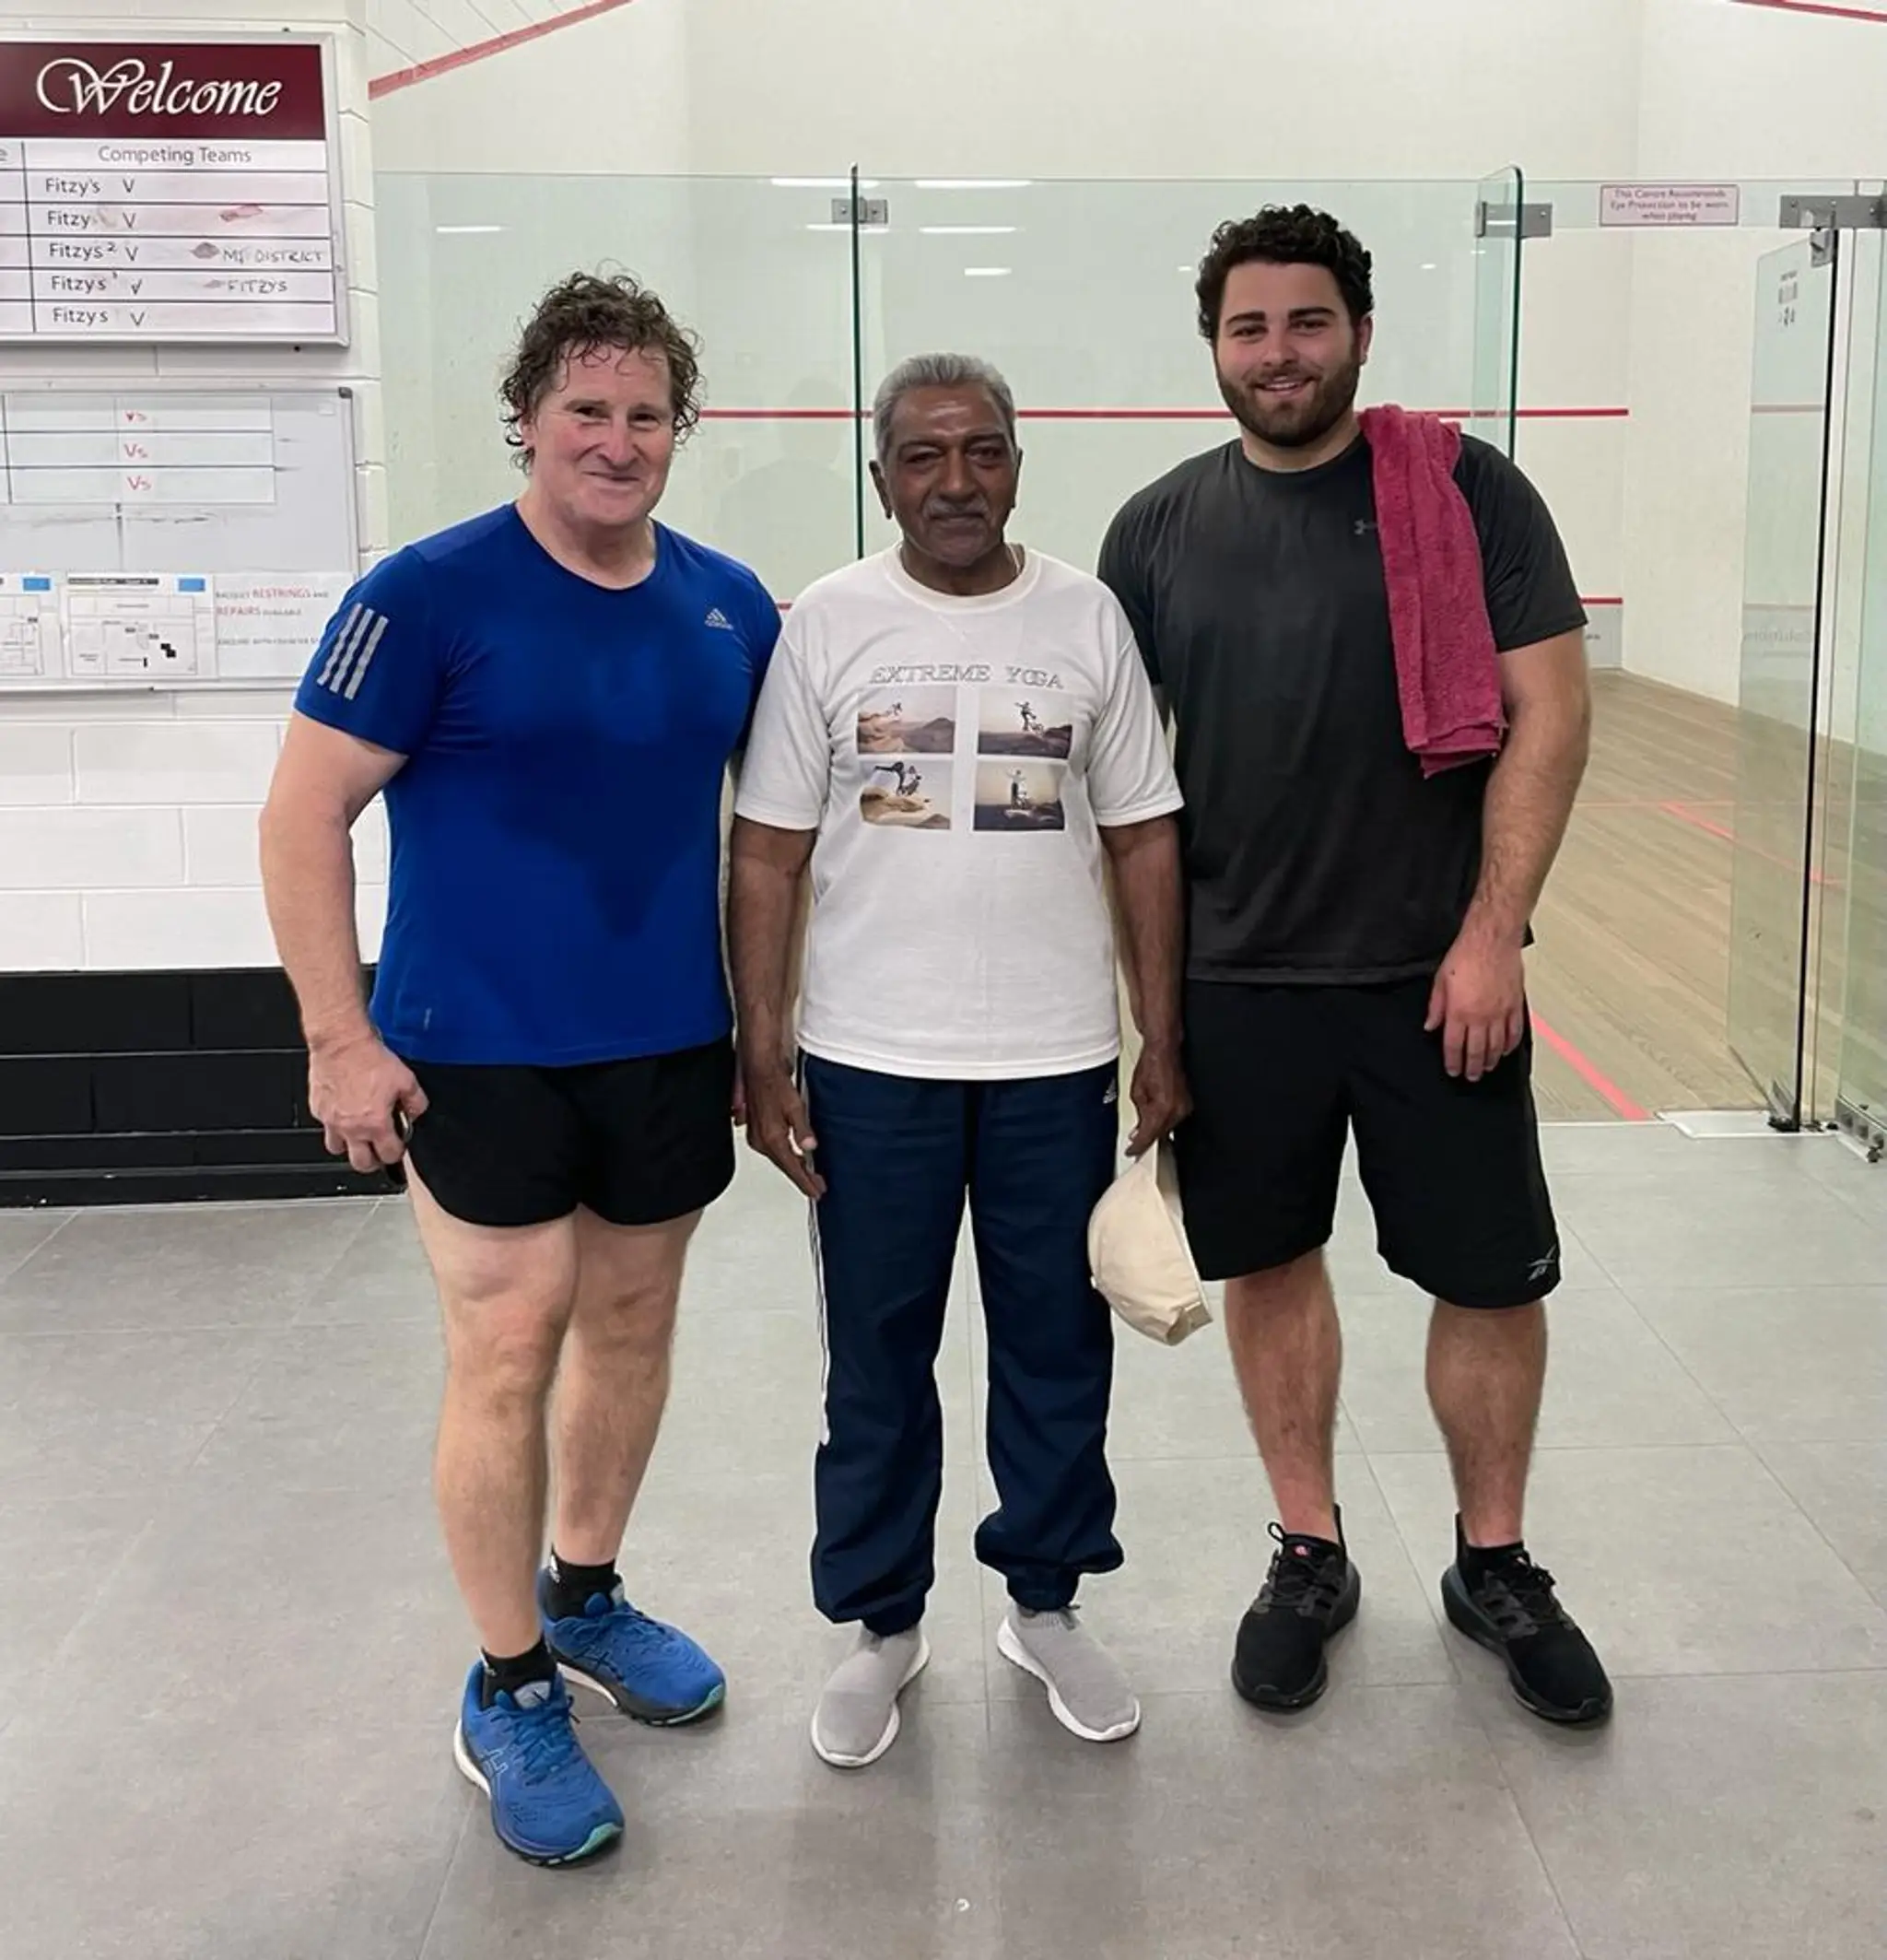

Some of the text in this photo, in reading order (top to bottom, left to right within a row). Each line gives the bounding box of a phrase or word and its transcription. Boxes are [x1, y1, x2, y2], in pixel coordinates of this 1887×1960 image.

[36, 57, 282, 116] Welcome
[98, 145, 252, 166] Competing Teams
[45, 178, 101, 197] Fitzy's
[252, 587, 311, 599] RESTRINGS
[870, 664, 1063, 688] EXTREME YOGA
